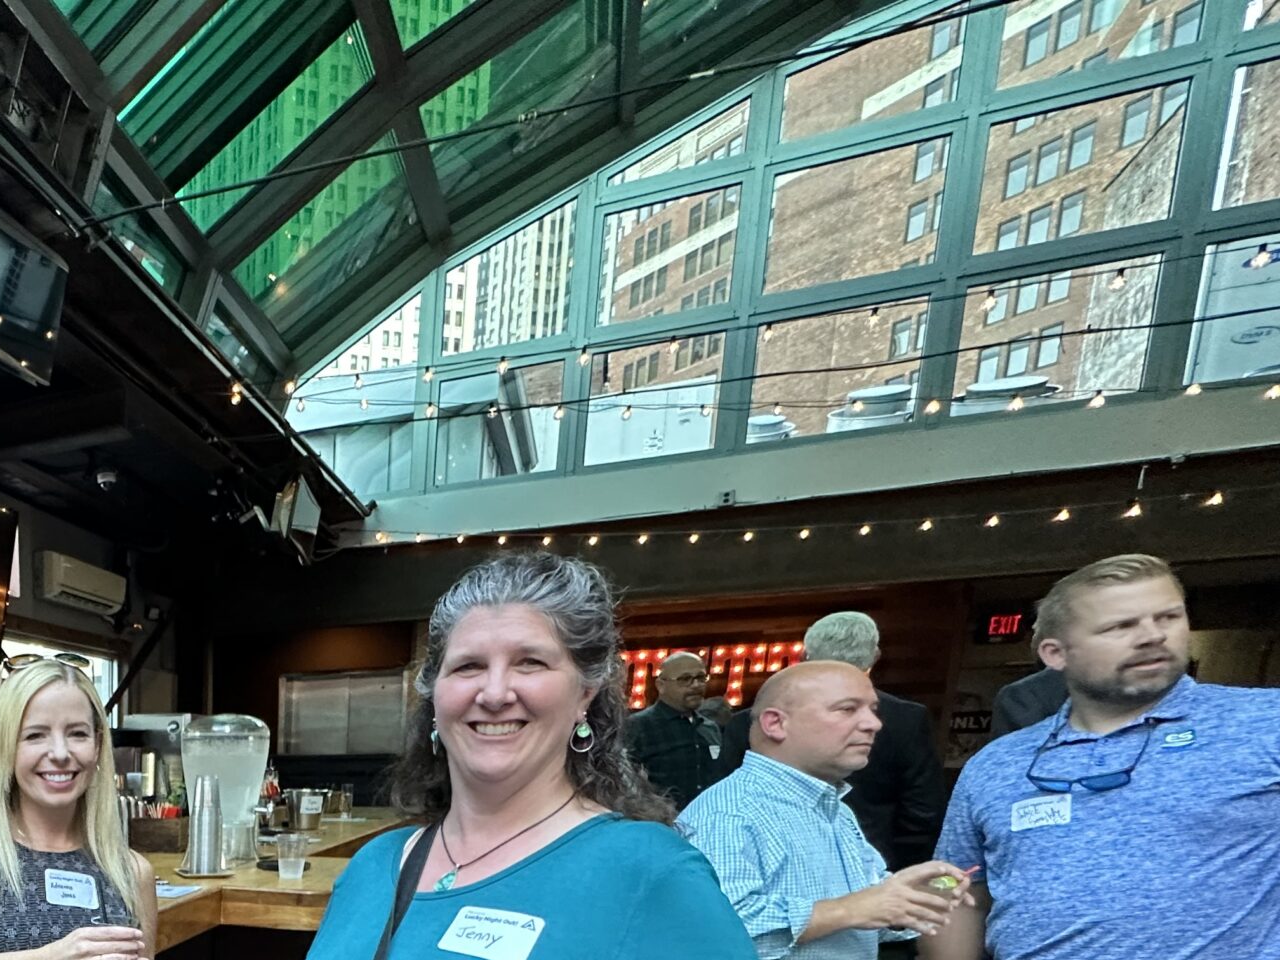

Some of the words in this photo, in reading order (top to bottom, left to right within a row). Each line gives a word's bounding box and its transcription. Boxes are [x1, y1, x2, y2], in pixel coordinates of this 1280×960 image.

[988, 615, 1022, 635] EXIT
[950, 716, 991, 730] NLY
[483, 916, 501, 924] Night
[456, 926, 503, 949] Jenny
